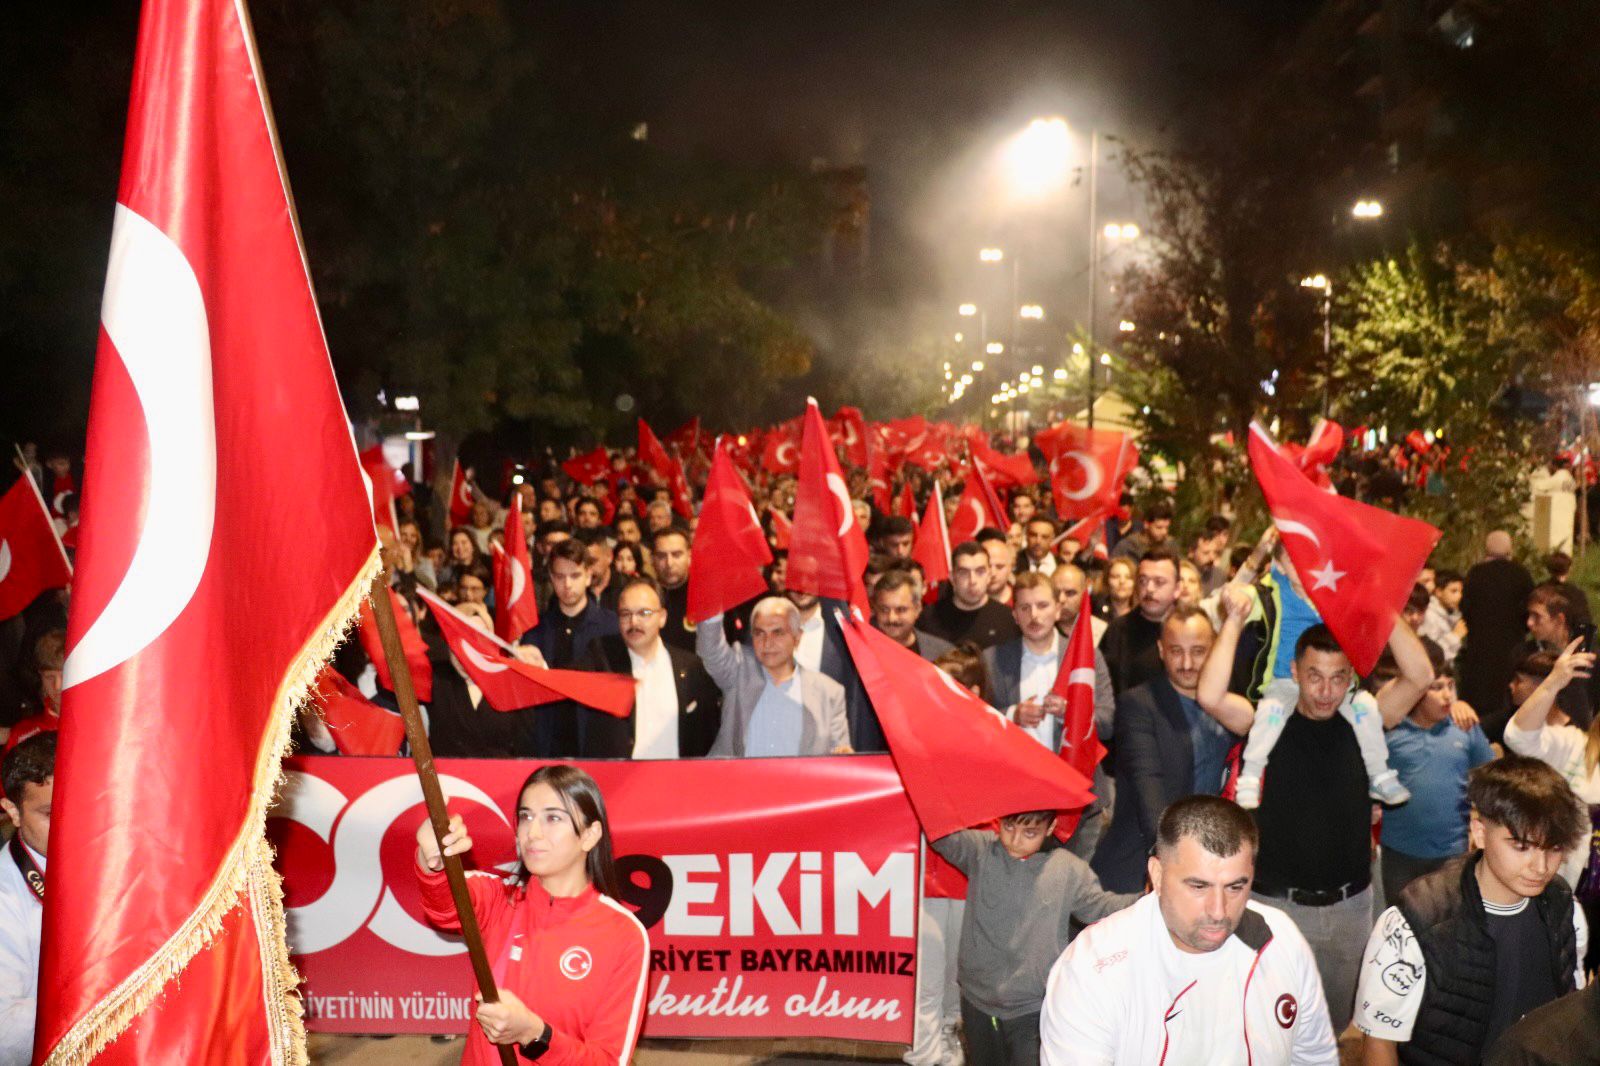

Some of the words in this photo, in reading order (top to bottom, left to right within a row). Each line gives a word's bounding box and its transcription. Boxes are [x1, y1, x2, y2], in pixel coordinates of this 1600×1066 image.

[740, 949, 914, 977] BAYRAMIMIZ
[302, 990, 394, 1019] İYETİ'NİN
[648, 974, 770, 1017] kutlu
[784, 976, 902, 1022] olsun
